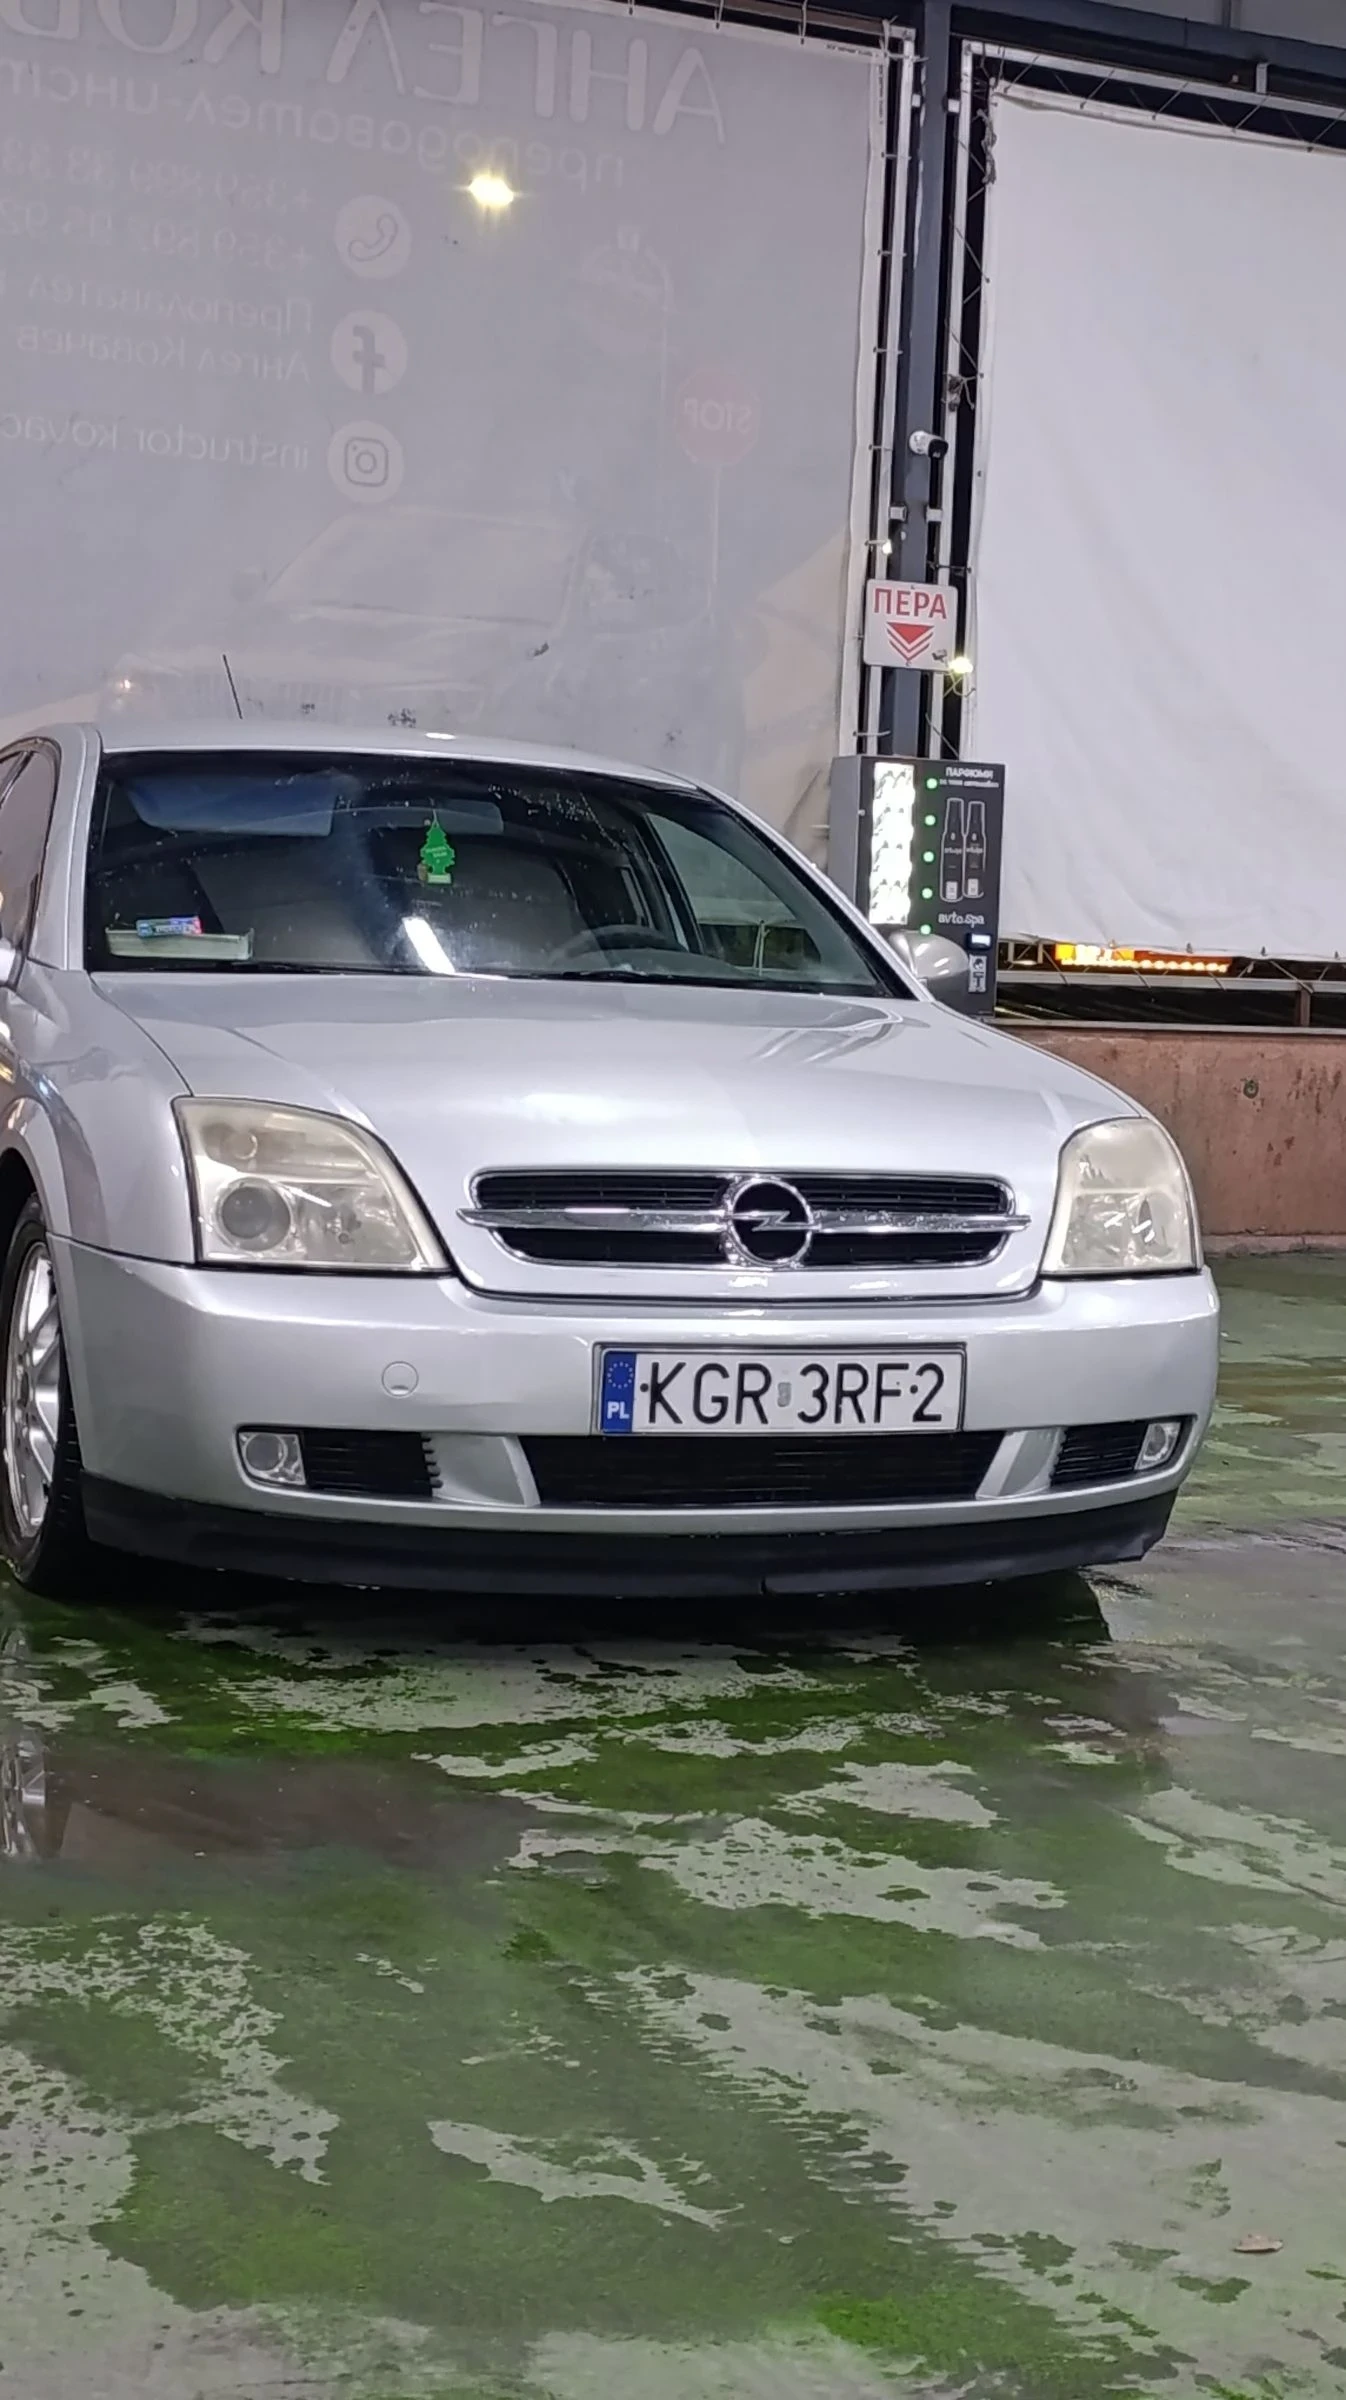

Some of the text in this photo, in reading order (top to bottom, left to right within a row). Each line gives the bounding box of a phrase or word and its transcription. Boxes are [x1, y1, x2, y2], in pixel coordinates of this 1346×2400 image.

[874, 588, 947, 620] ПЕРА
[607, 1361, 945, 1424] PL KGR 3RF2
